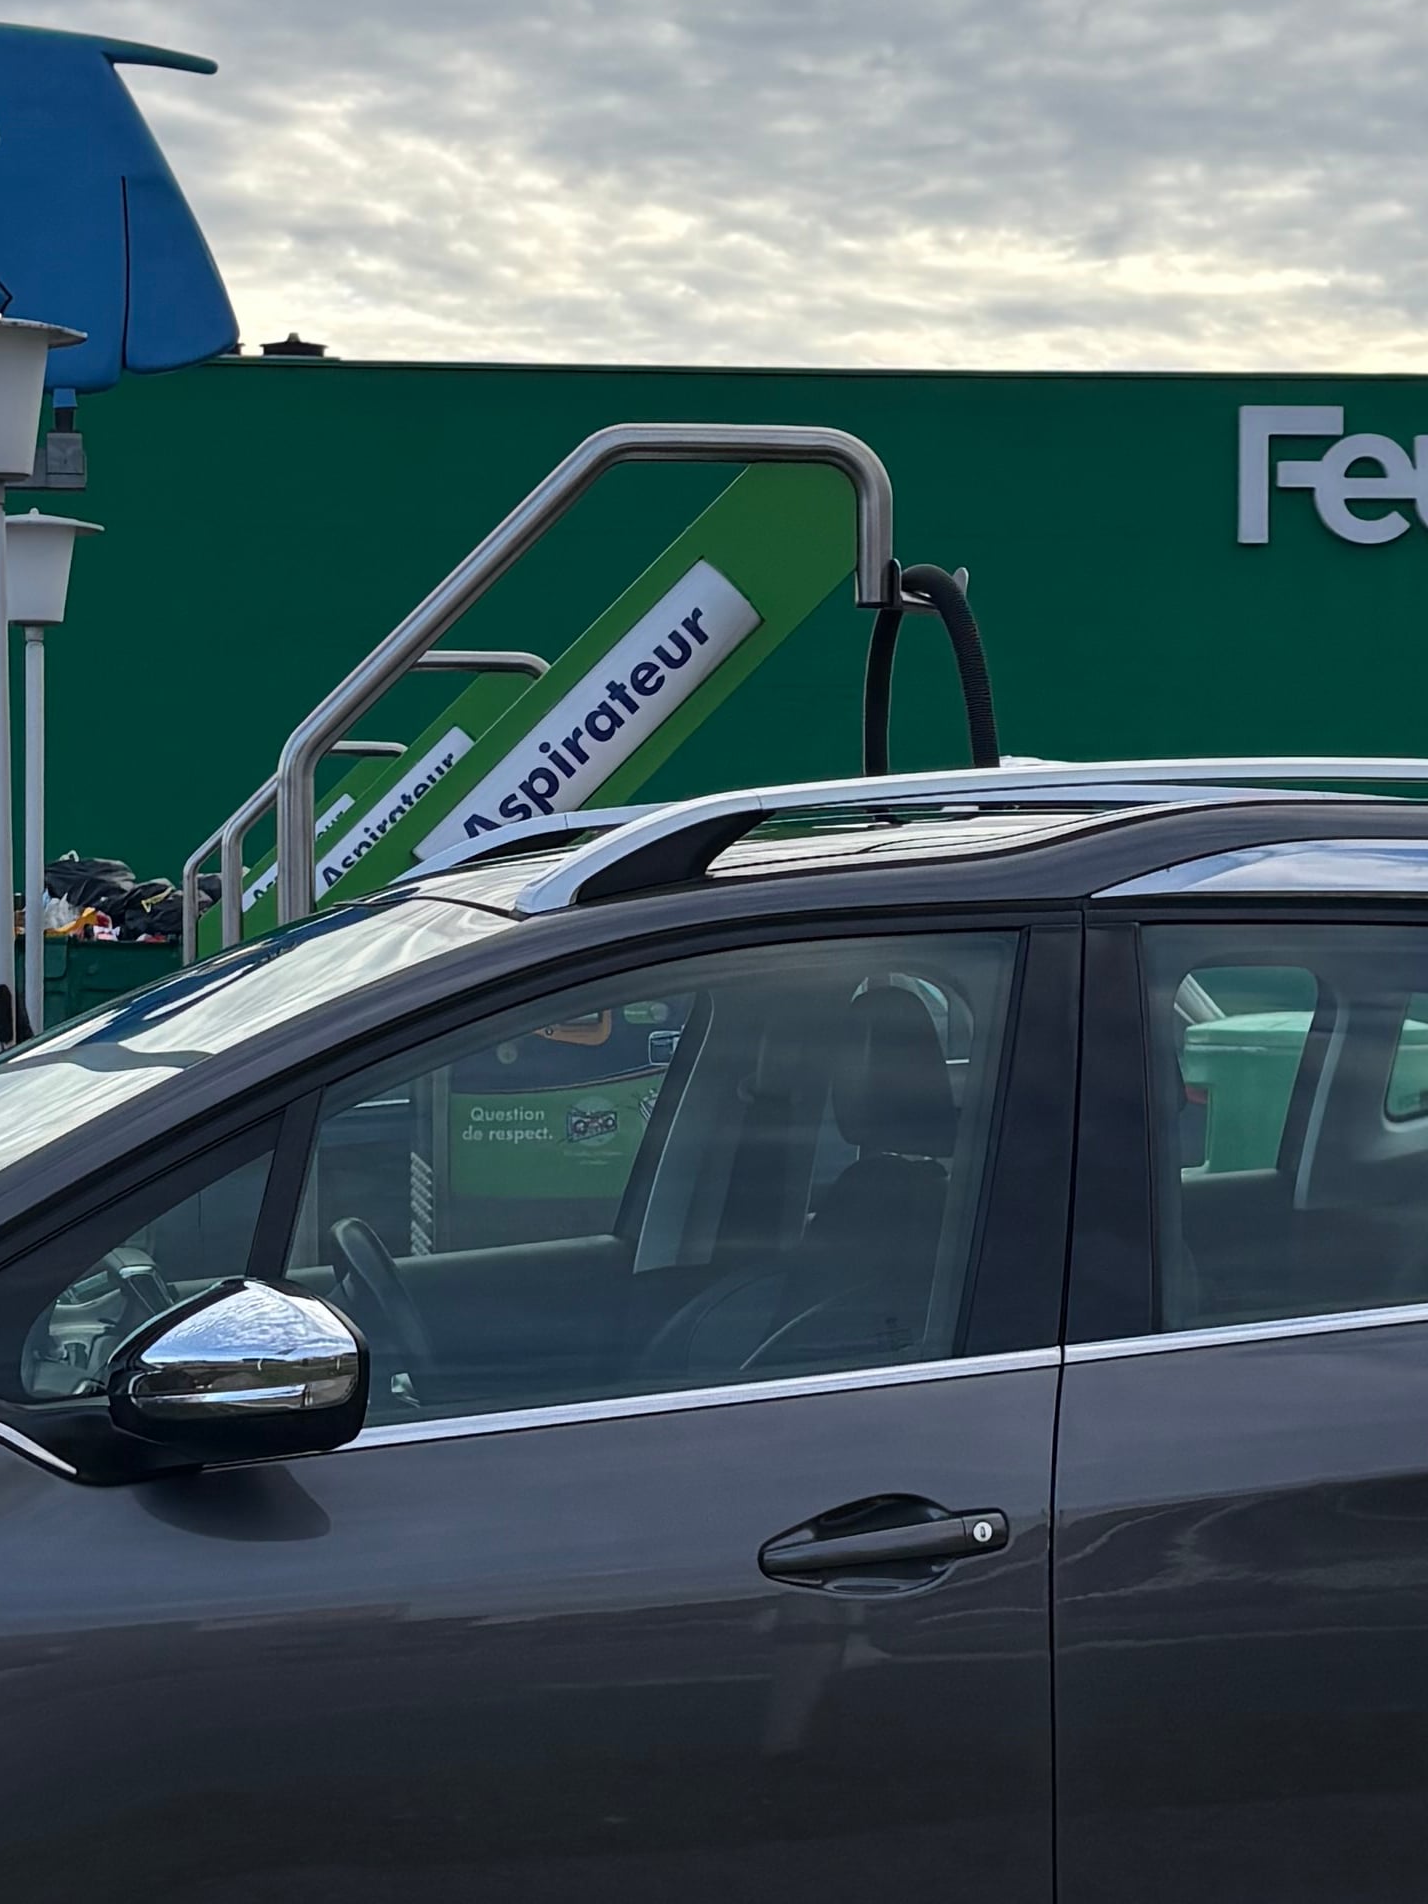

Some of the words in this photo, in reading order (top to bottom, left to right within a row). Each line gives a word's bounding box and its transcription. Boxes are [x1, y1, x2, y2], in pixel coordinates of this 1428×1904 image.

[463, 607, 710, 839] Aspirateur
[471, 1106, 545, 1122] Question
[462, 1125, 483, 1141] de
[488, 1127, 554, 1144] respect.
